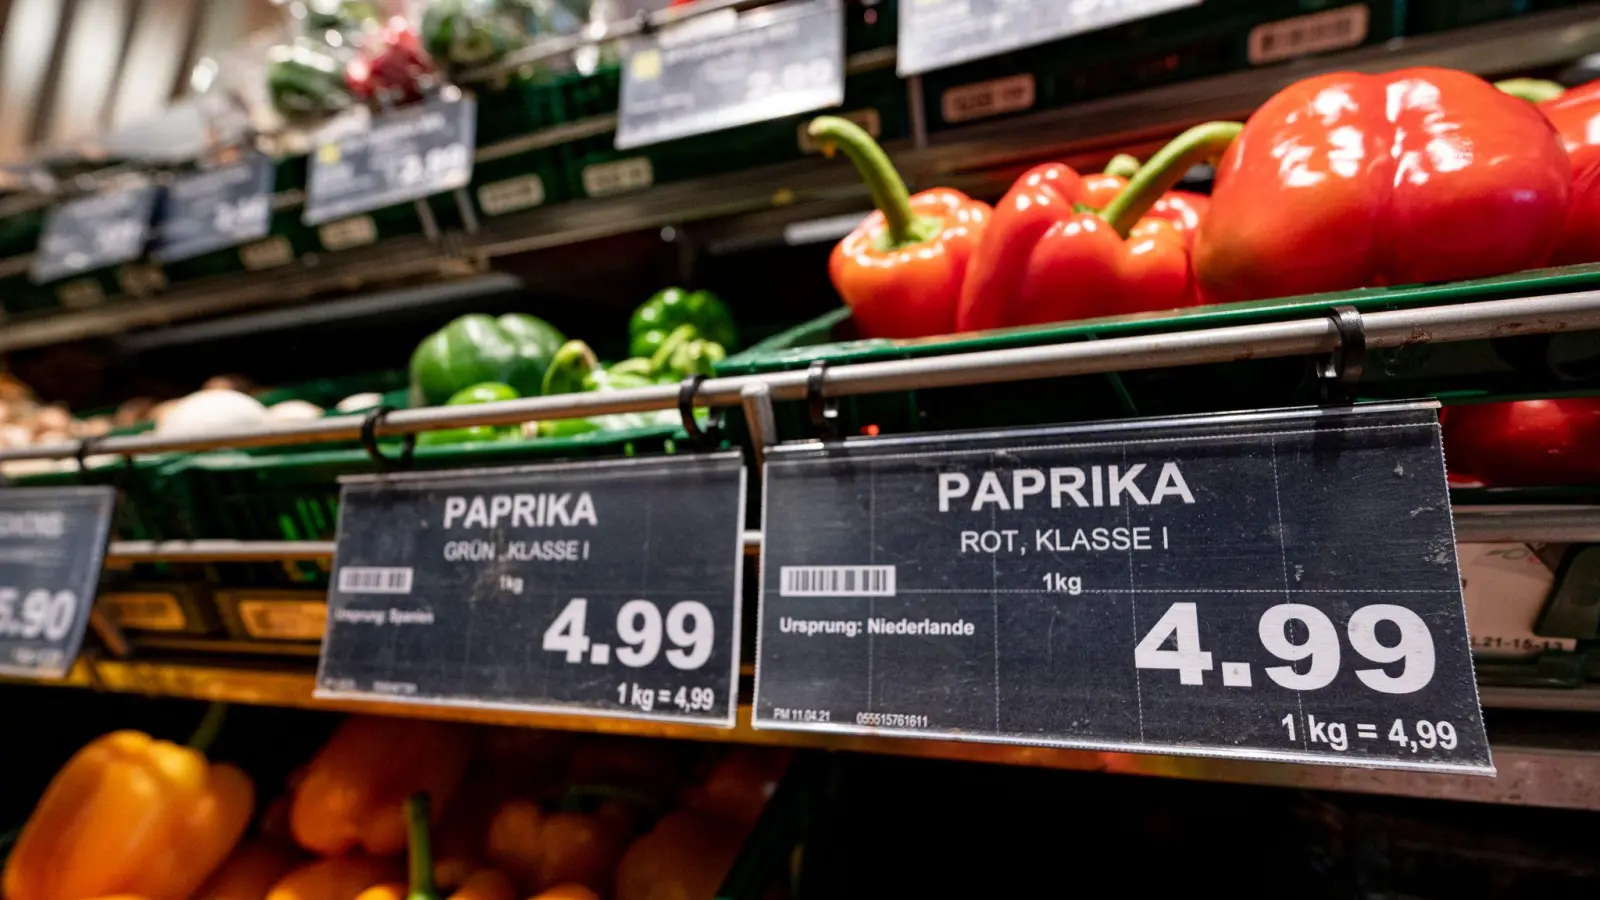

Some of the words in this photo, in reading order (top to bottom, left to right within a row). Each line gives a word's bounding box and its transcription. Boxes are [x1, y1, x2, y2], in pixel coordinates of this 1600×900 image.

[938, 462, 1196, 513] PAPRIKA
[443, 492, 598, 529] PAPRIKA
[508, 540, 580, 562] KLASSE
[582, 541, 590, 560] I
[960, 529, 1026, 556] ROT,
[1035, 527, 1152, 552] KLASSE
[1162, 526, 1169, 550] I
[1042, 572, 1082, 595] 1kg
[543, 598, 714, 670] 4.99
[779, 616, 863, 638] Ursprung:
[867, 617, 976, 637] Niederlande
[1134, 602, 1436, 694] 4.99
[617, 683, 626, 706] 1
[630, 683, 654, 712] kg
[674, 686, 715, 713] 4,99
[773, 708, 790, 720] PM
[791, 709, 831, 722] 11.04.21
[1281, 713, 1297, 741] 1
[1307, 714, 1349, 752] kg
[1357, 723, 1378, 739] =
[1387, 718, 1458, 753] 4,99
